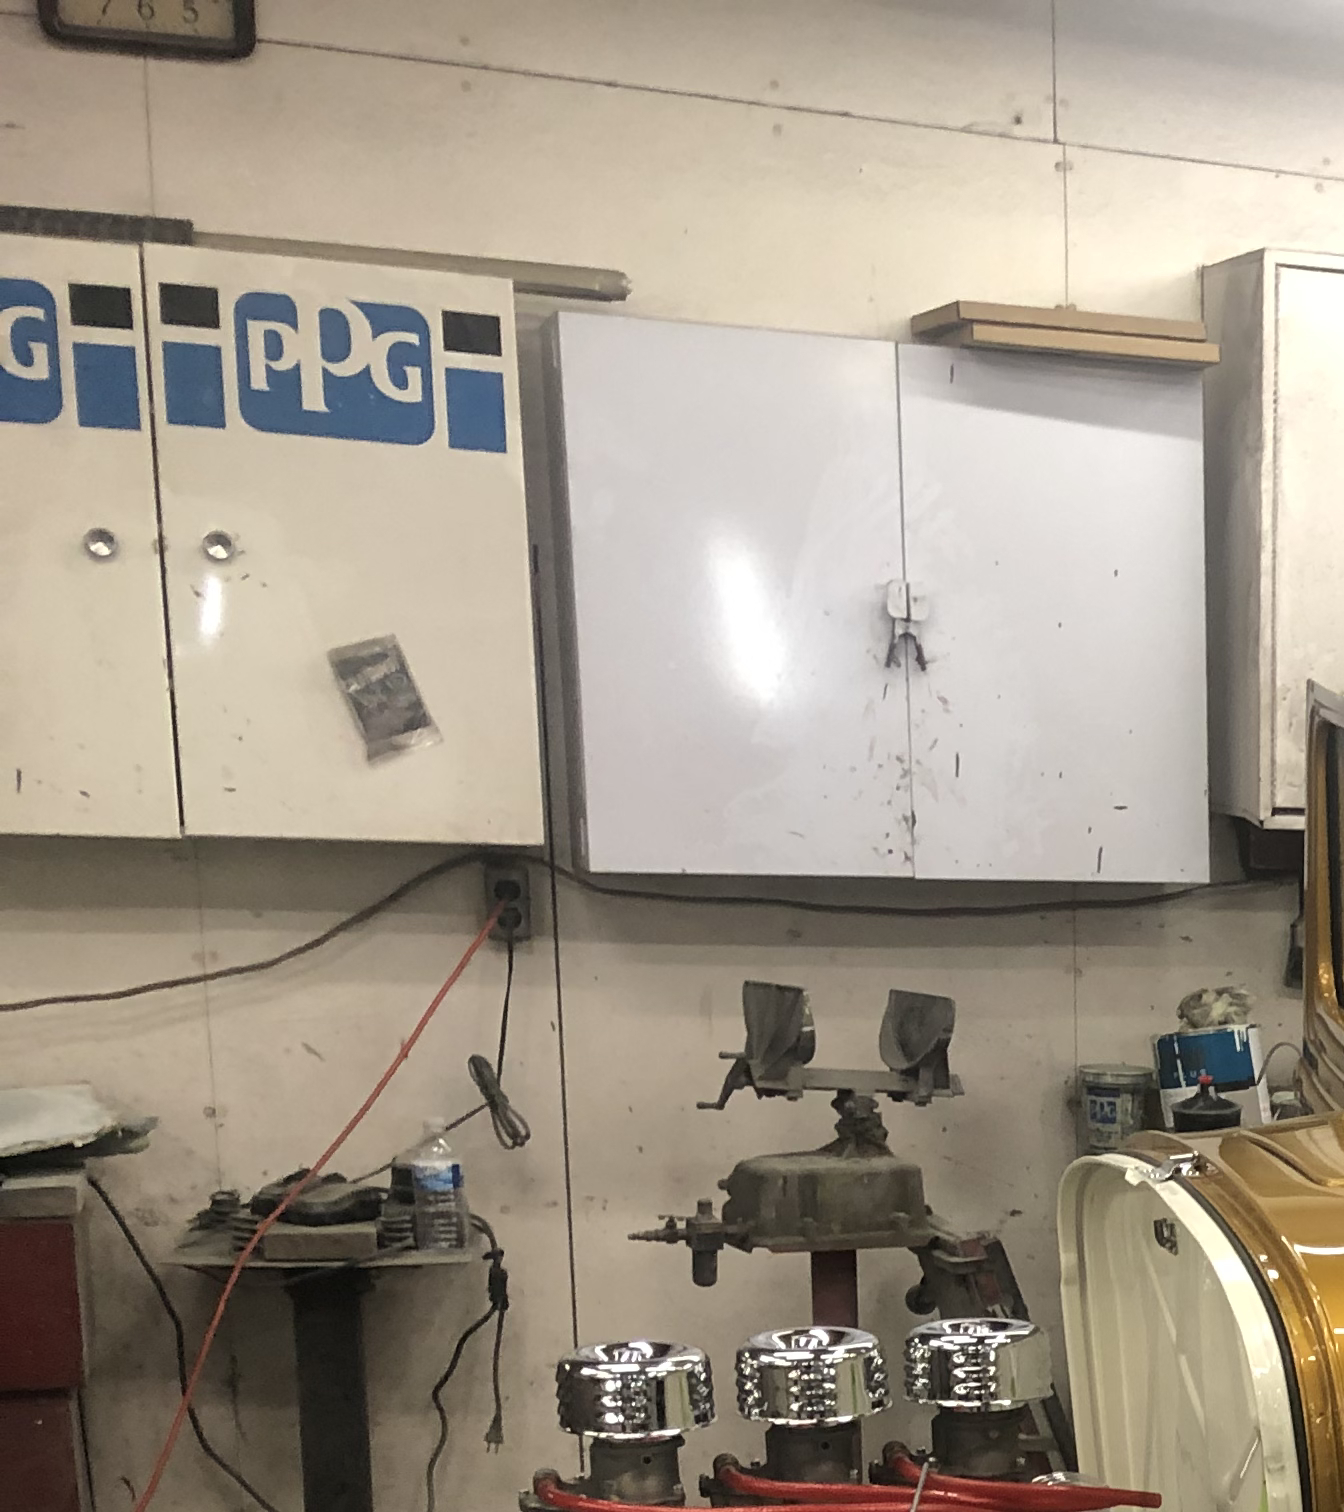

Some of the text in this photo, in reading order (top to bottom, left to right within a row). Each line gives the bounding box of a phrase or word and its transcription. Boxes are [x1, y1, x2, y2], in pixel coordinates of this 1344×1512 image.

[137, 0, 155, 21] 6
[182, 0, 199, 24] 5
[246, 297, 424, 414] PPG
